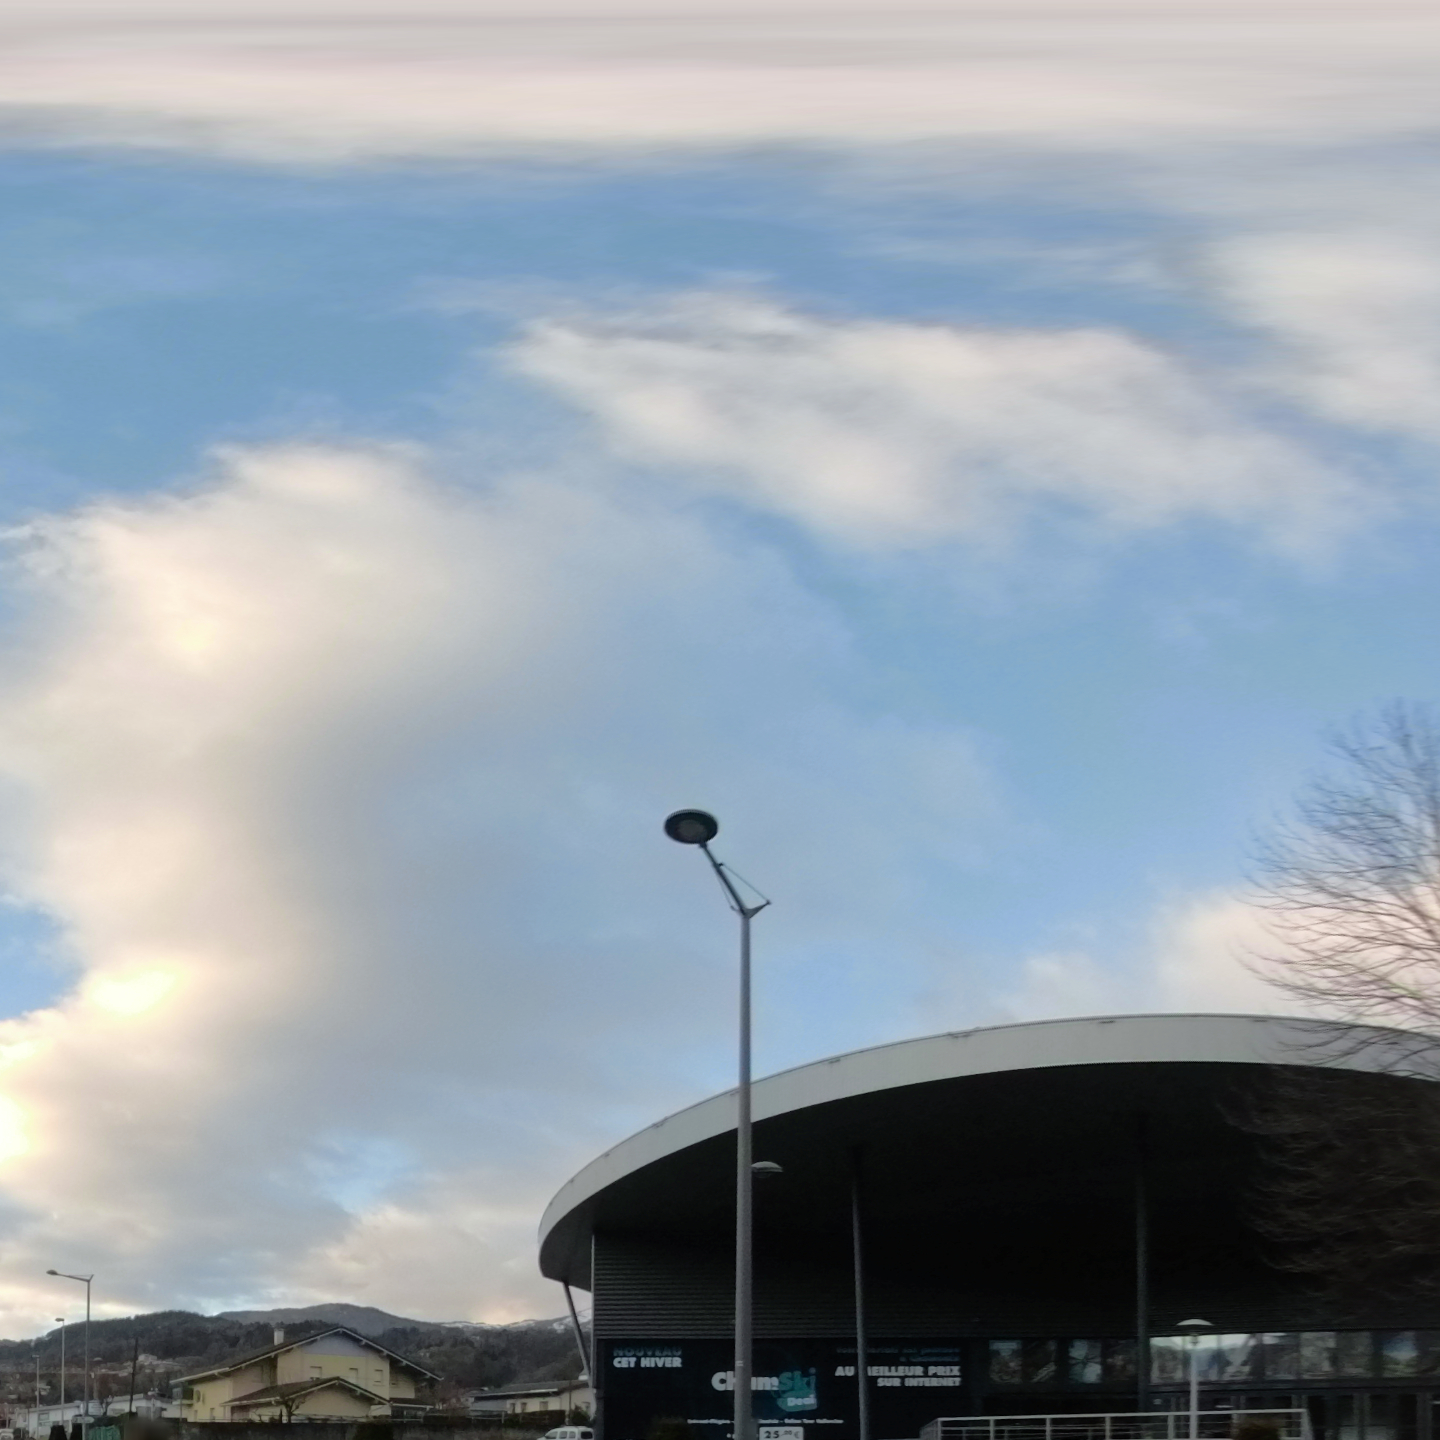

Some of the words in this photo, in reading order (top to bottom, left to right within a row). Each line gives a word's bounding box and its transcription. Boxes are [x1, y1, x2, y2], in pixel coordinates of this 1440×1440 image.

[613, 1346, 682, 1357] NOUVEAU
[613, 1357, 637, 1368] CET
[640, 1357, 683, 1368] HIVER
[835, 1366, 855, 1376] AU
[927, 1366, 961, 1376] PRIX
[877, 1378, 902, 1387] SUR
[904, 1378, 962, 1387] INTERNET
